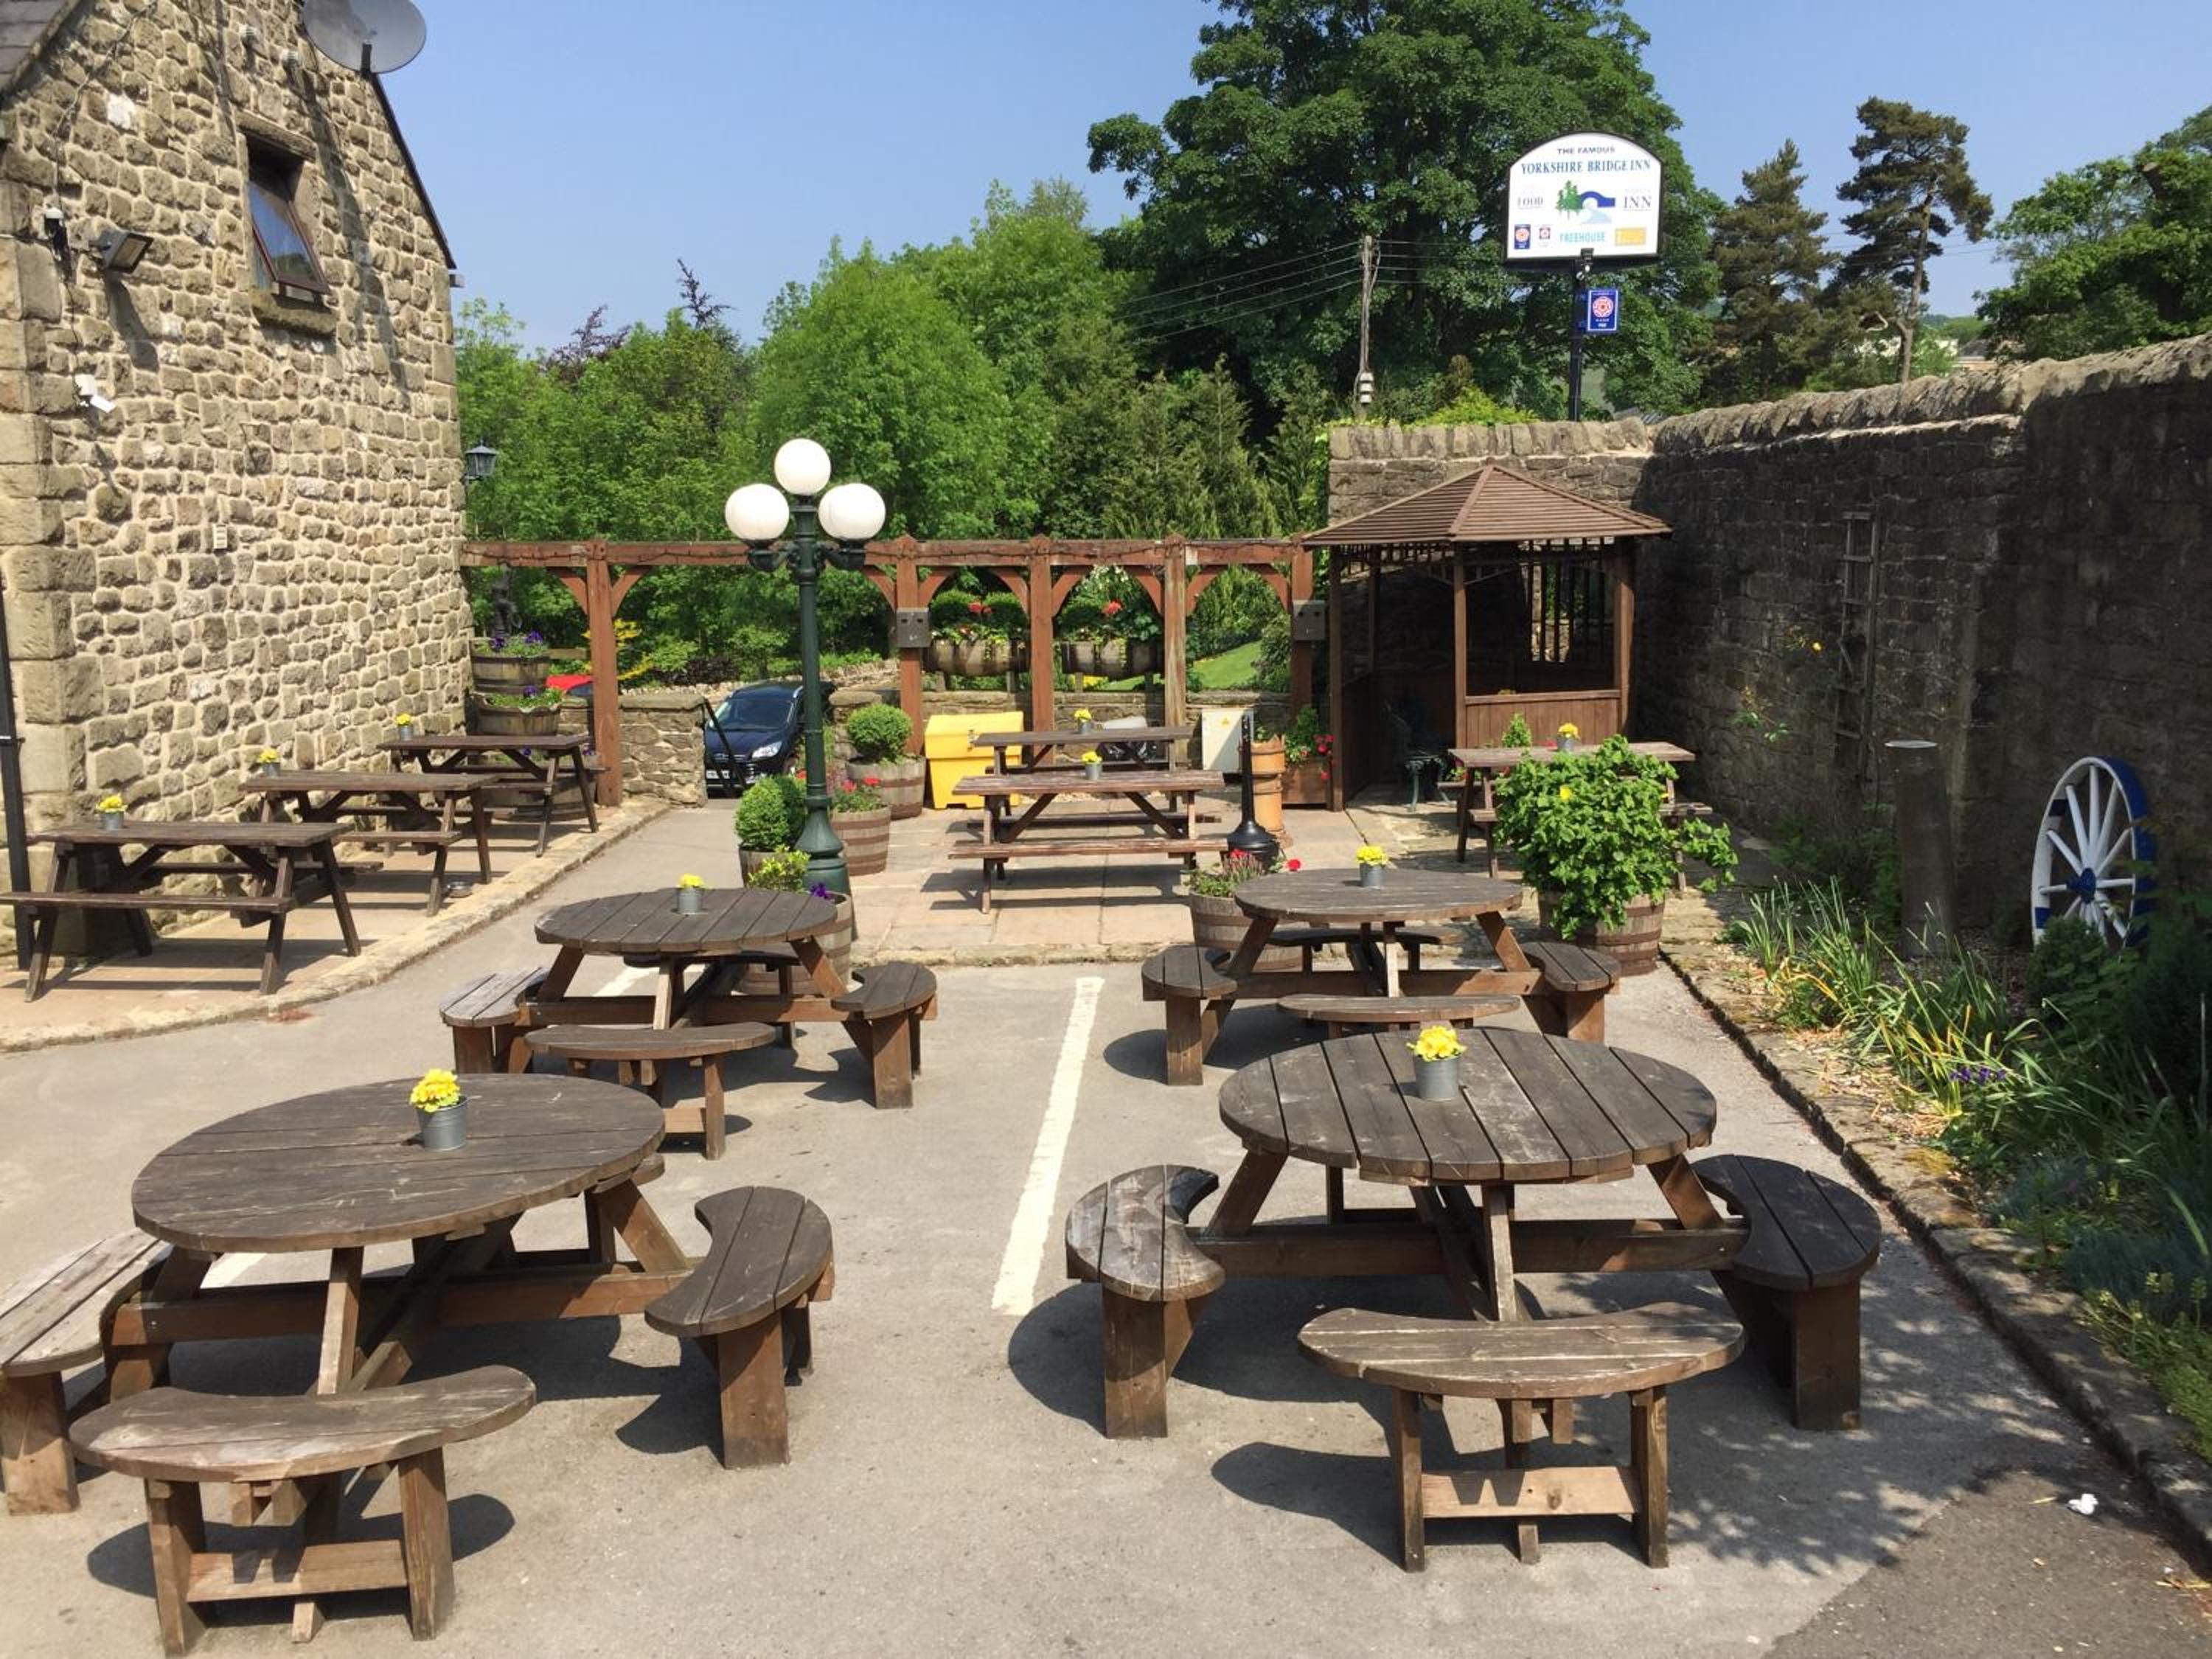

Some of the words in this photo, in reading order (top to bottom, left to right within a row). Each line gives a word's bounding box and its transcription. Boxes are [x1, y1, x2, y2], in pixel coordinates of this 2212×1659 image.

[1521, 161, 1582, 174] YORKSHIRE
[1587, 160, 1627, 172] BRIDGE
[1630, 159, 1651, 170] INN
[1623, 195, 1652, 209] INN
